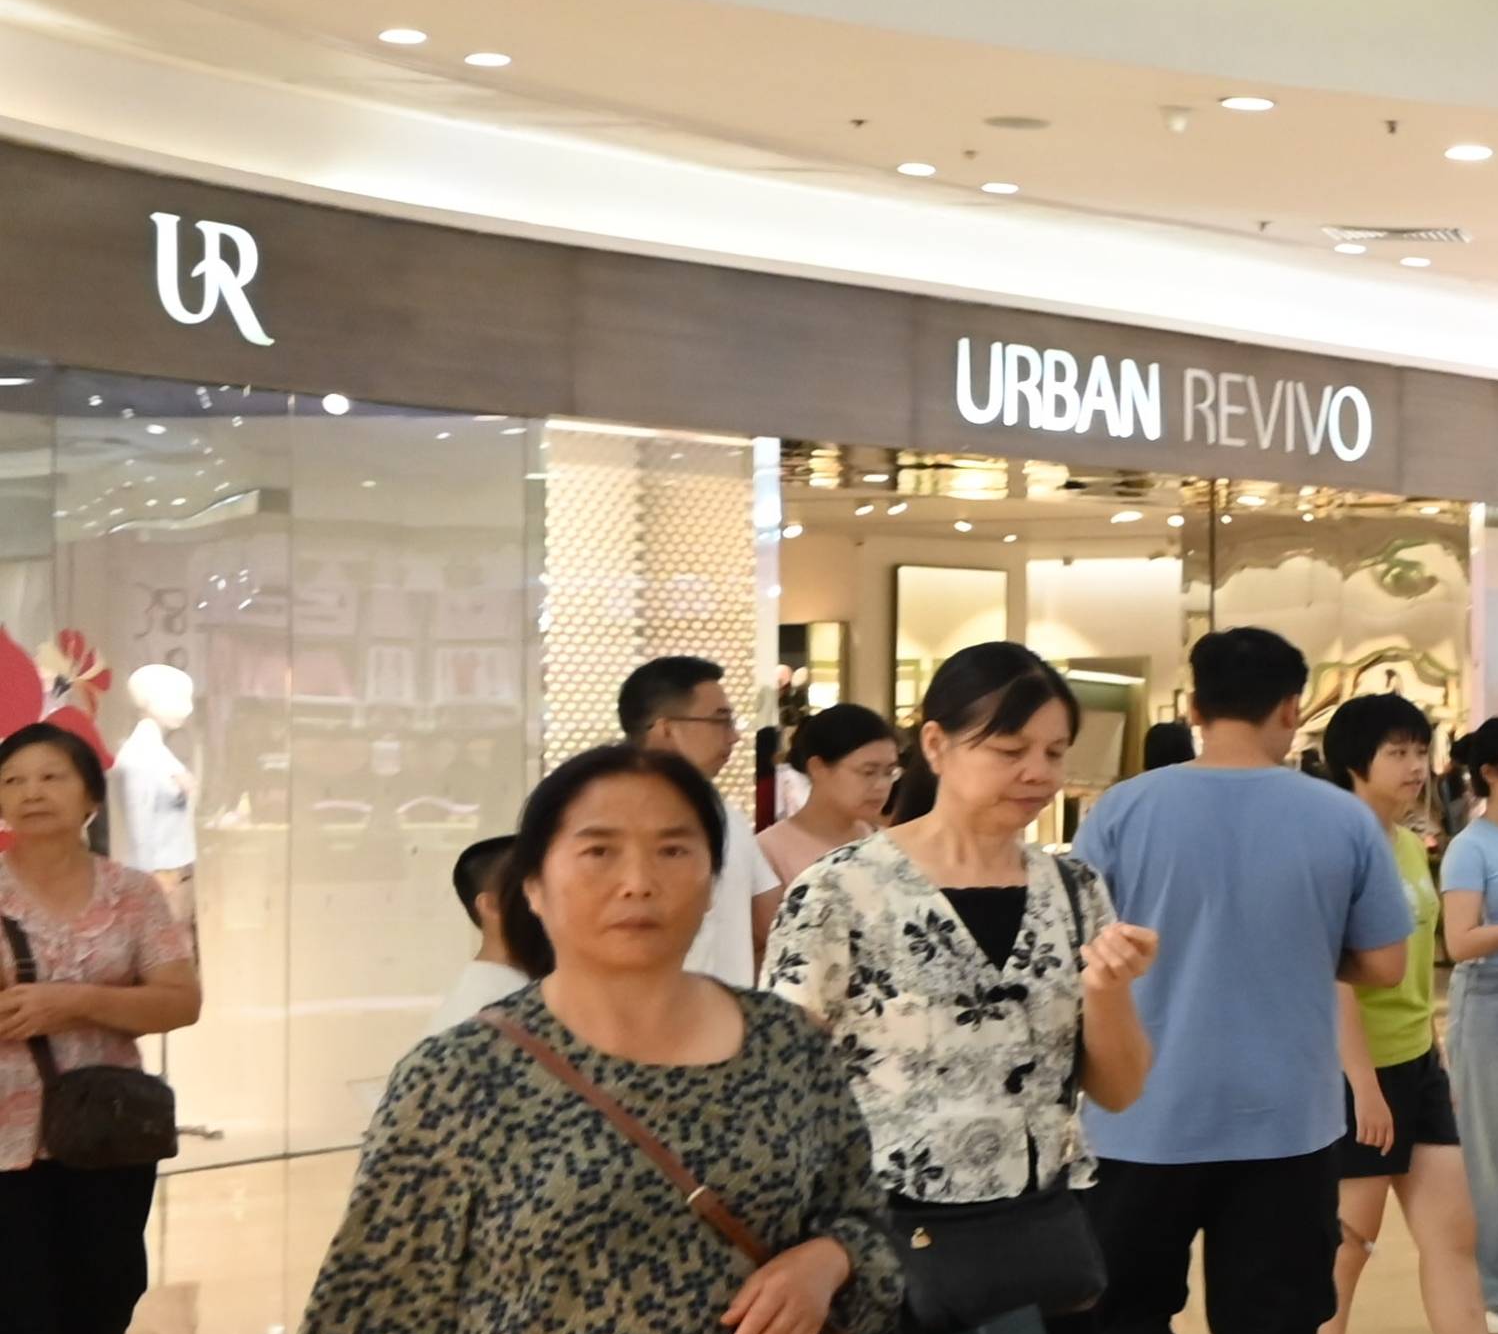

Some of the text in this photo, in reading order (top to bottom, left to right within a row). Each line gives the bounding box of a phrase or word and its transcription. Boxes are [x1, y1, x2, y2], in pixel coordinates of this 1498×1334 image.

[149, 212, 275, 347] UR
[956, 336, 1372, 462] URBAN REVIVO
